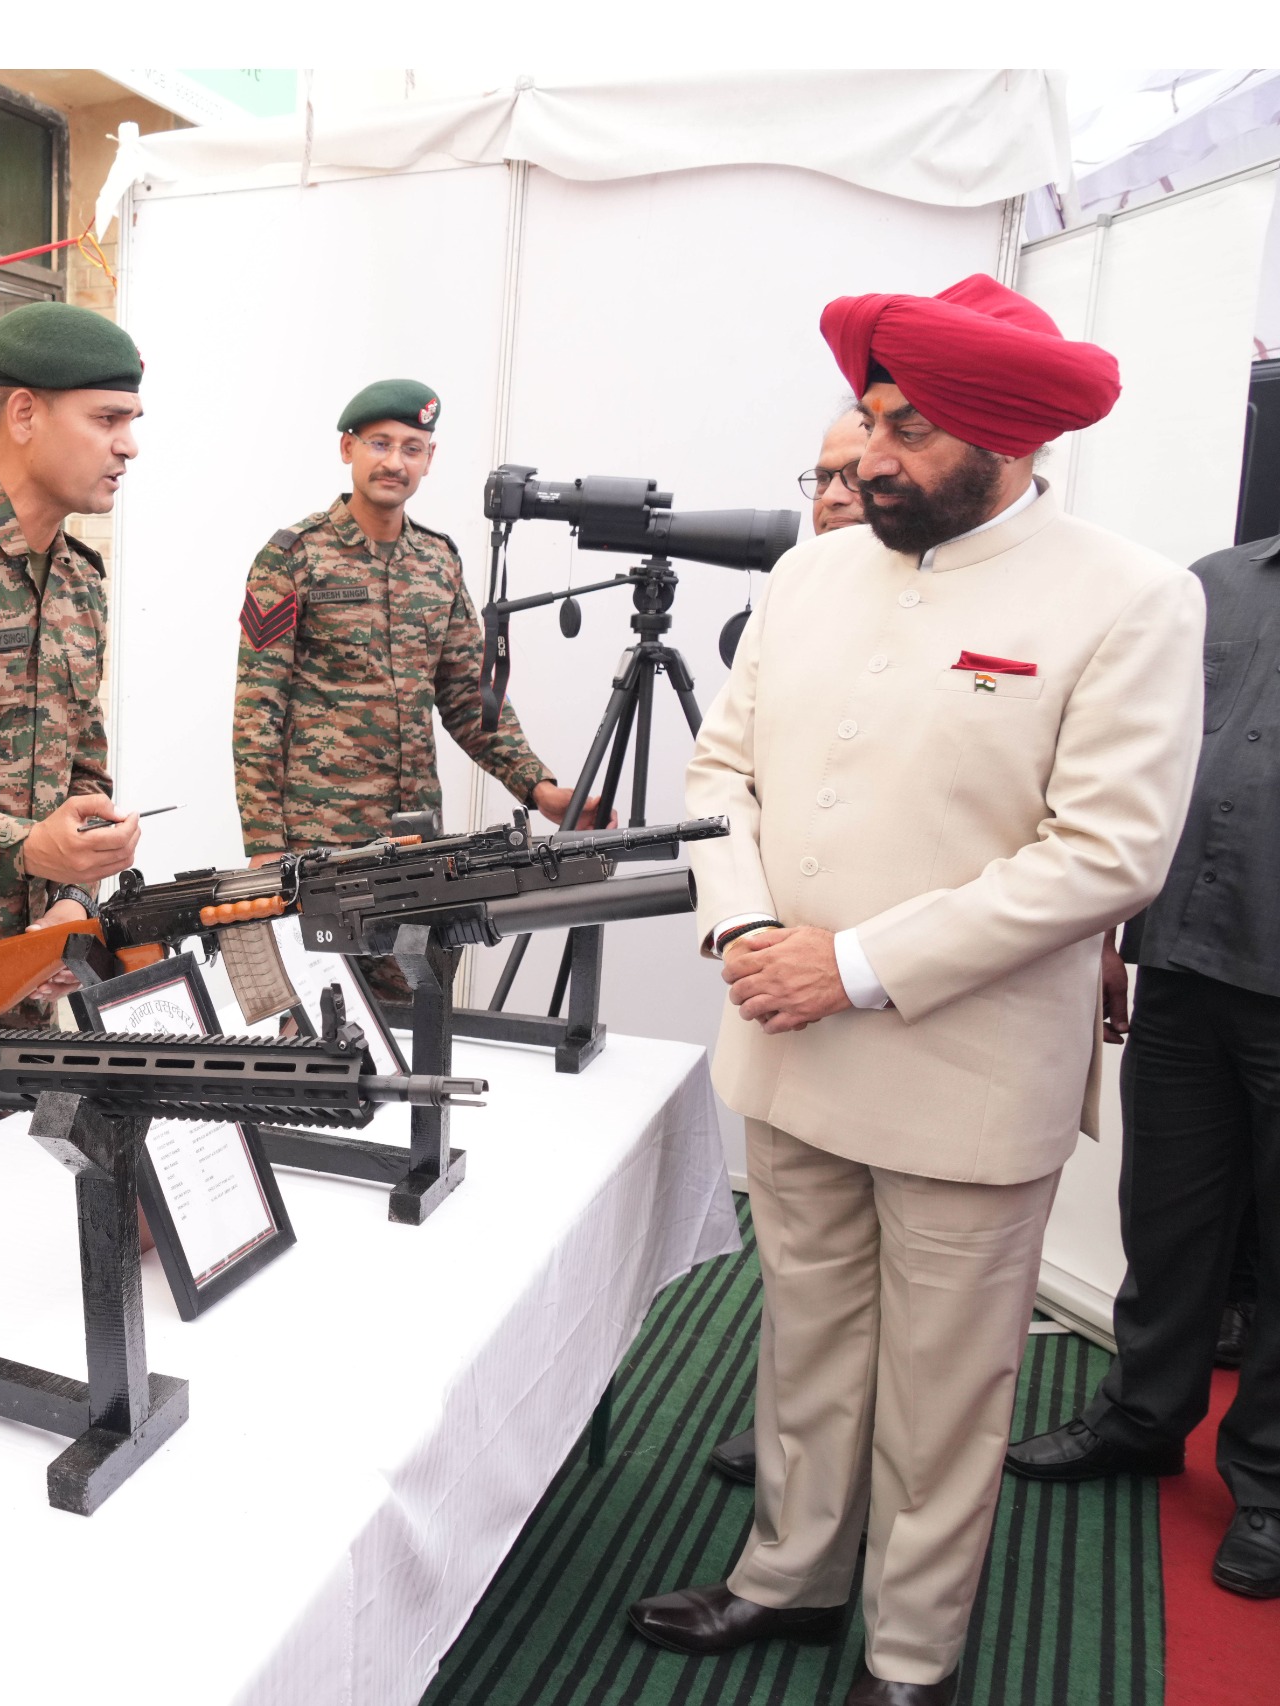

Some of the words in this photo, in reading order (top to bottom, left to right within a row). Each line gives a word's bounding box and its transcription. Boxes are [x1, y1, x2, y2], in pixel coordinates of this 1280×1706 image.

[311, 590, 341, 601] SURESH
[342, 588, 367, 599] SINGH
[3, 632, 28, 645] SINGH
[497, 635, 506, 657] EOS
[316, 930, 333, 943] 80
